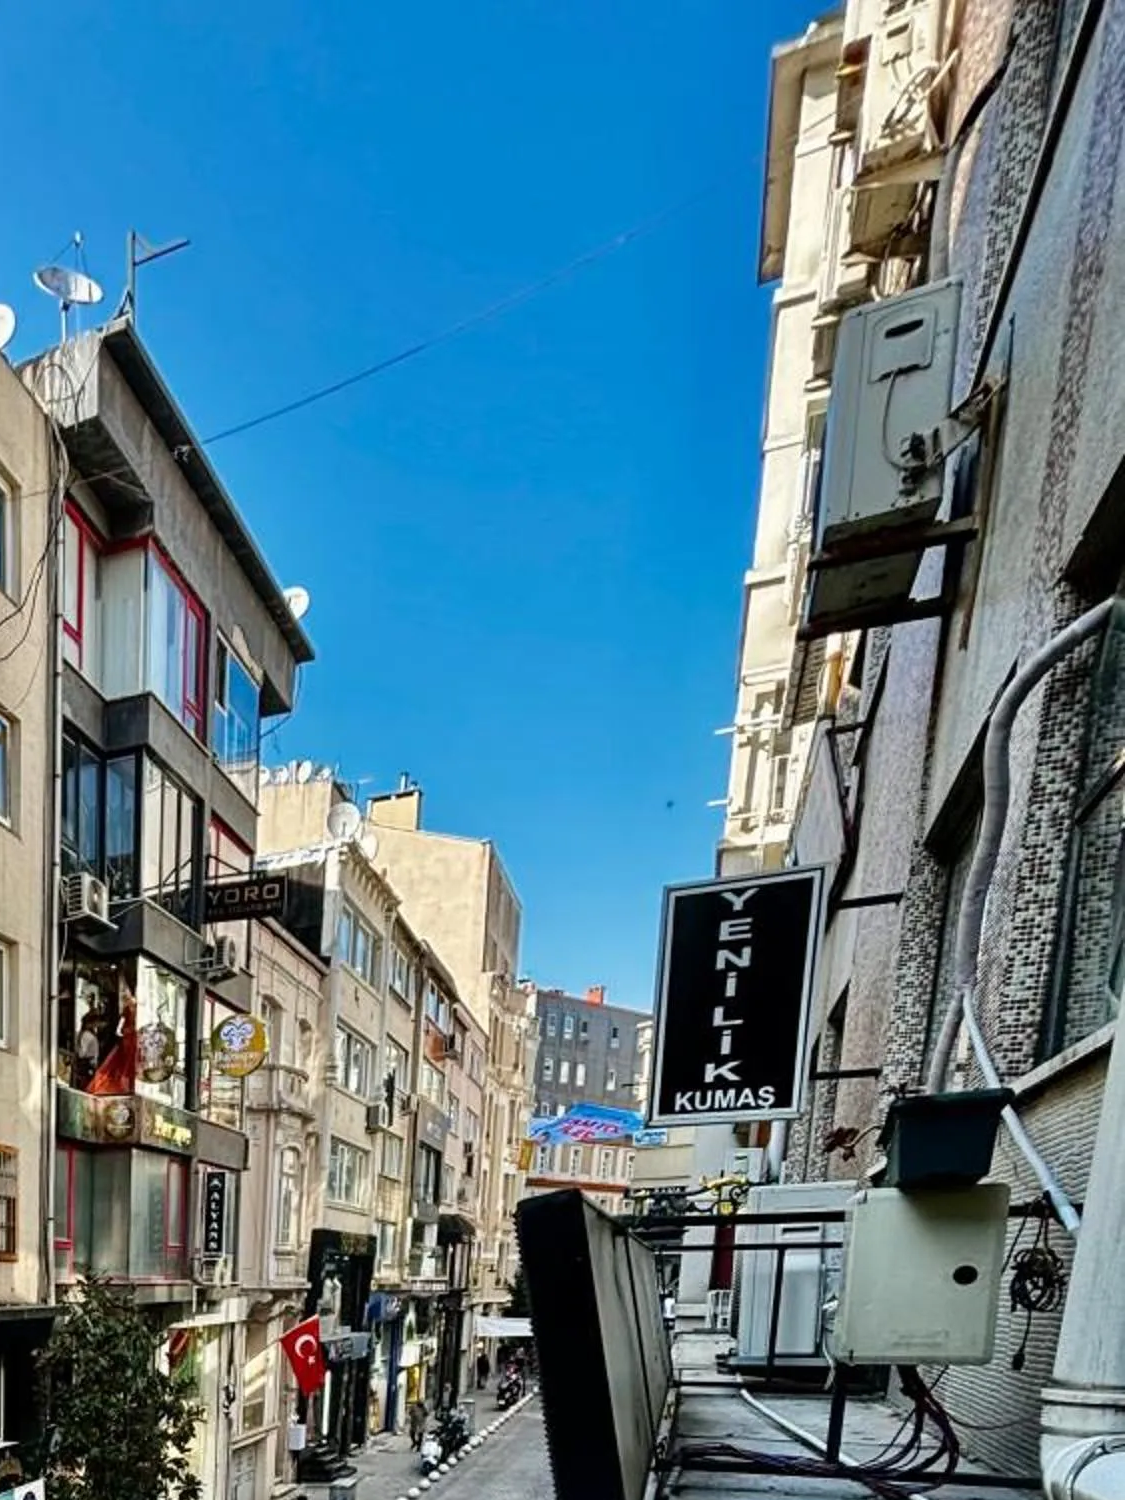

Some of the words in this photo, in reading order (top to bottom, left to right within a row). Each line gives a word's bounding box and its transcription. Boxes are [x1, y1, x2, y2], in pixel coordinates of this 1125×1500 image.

[207, 883, 281, 905] YORO
[703, 887, 760, 1083] YENİLİK
[674, 1086, 776, 1112] KUMAŞ
